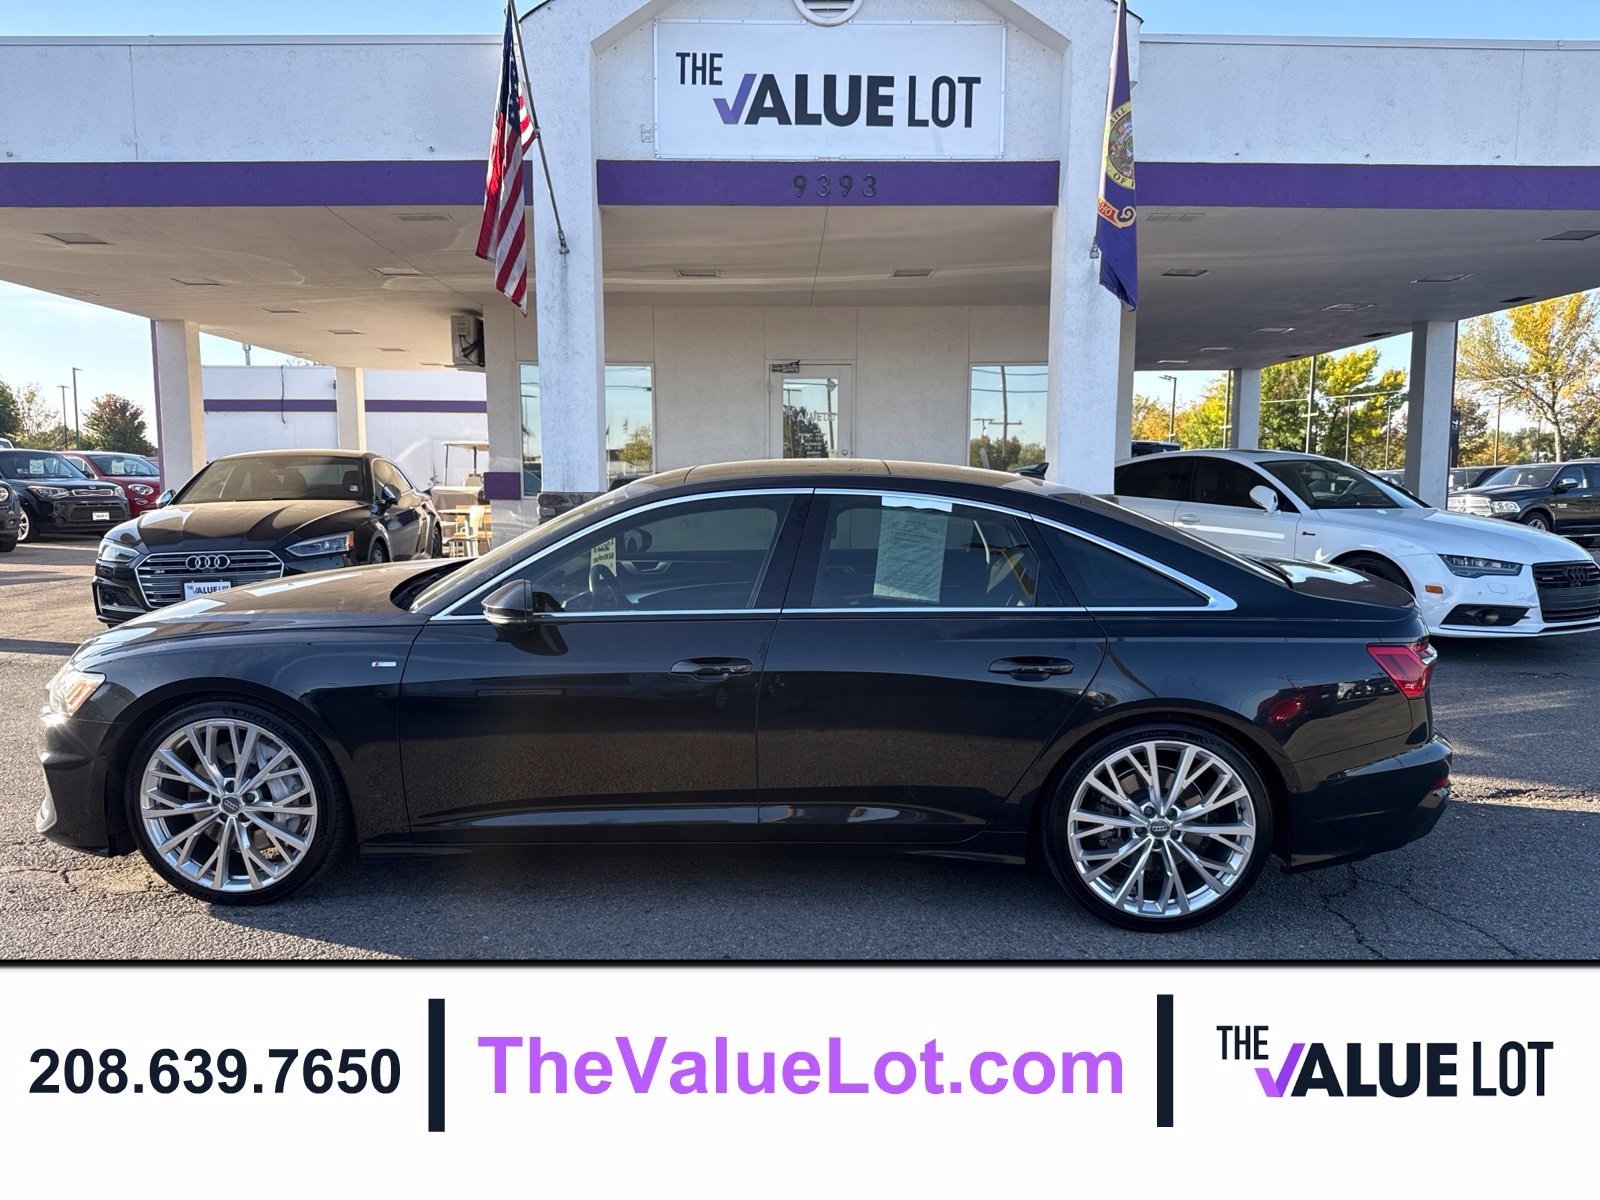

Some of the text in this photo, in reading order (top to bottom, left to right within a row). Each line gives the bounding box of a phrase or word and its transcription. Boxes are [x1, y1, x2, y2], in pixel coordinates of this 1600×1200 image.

[675, 52, 723, 86] THE
[712, 73, 982, 128] VALUE LOT
[793, 173, 878, 199] 9393
